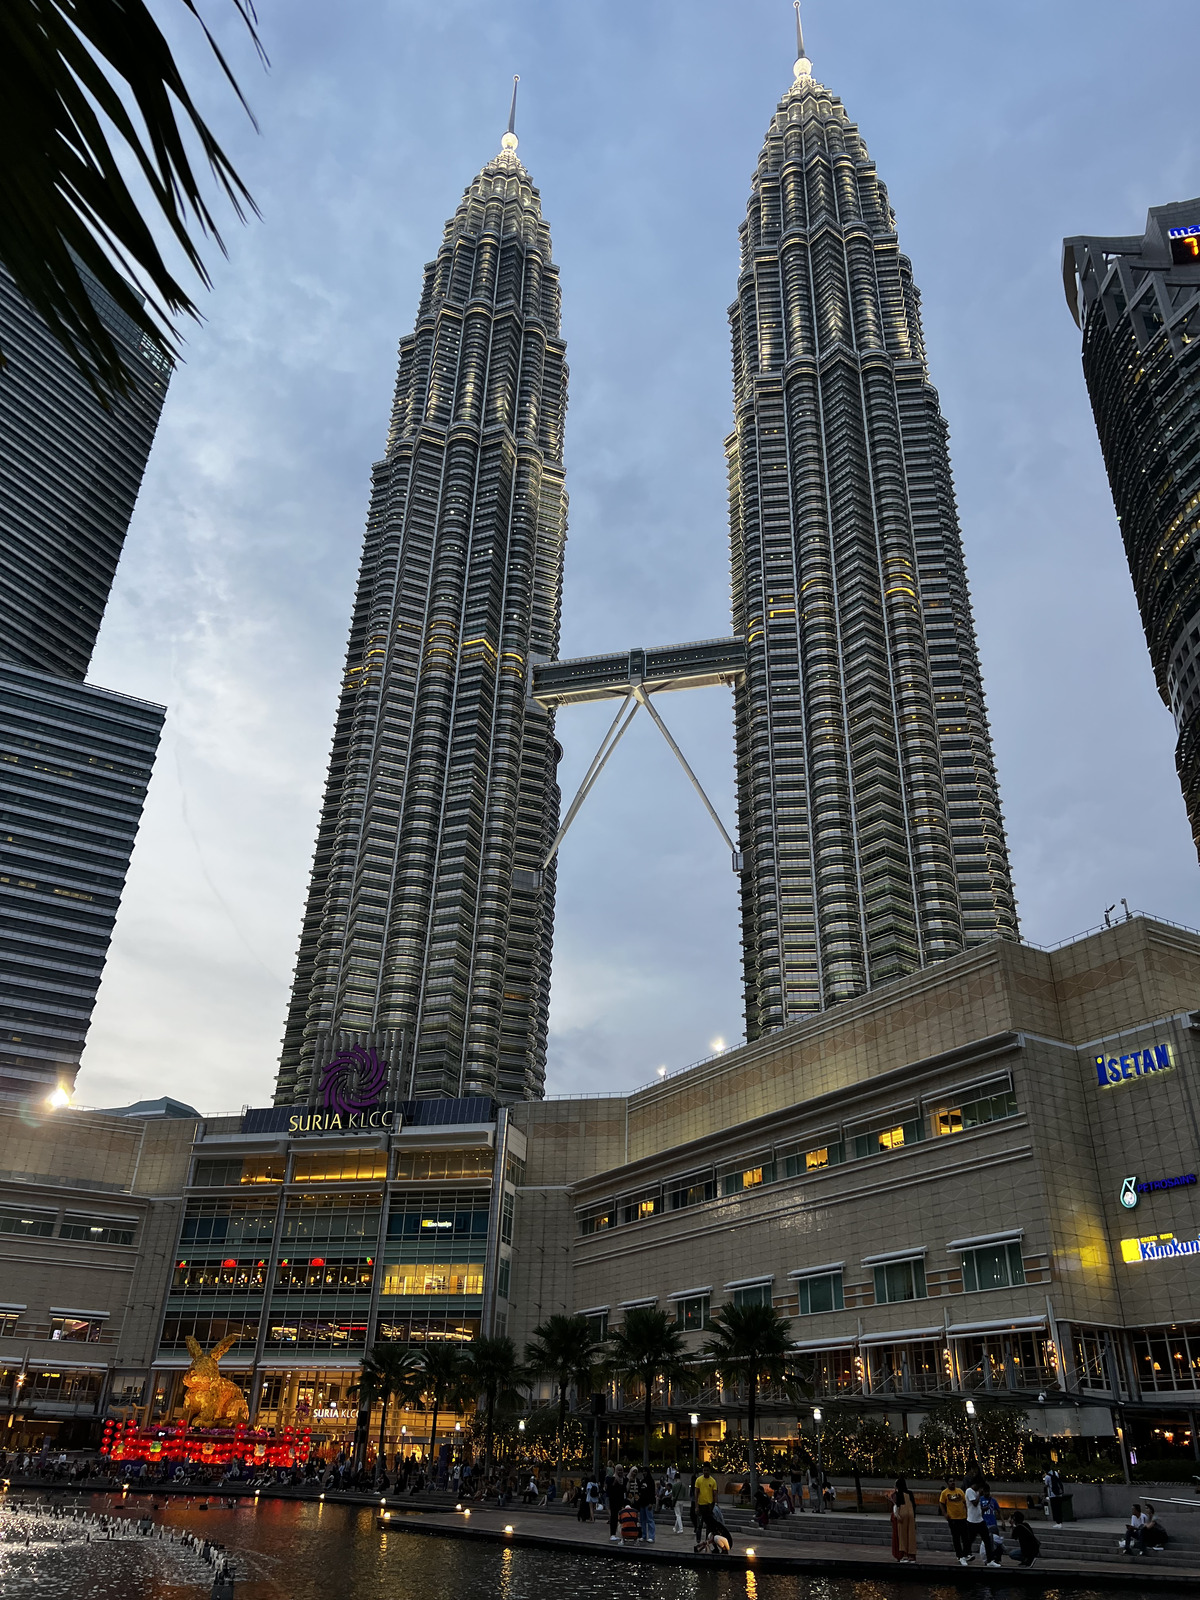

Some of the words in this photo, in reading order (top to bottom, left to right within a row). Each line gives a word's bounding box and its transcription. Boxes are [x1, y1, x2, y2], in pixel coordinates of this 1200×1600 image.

[1169, 224, 1200, 239] ma
[288, 1113, 342, 1132] SURIA
[348, 1110, 393, 1128] KLCC
[1137, 1174, 1196, 1193] PETROSAINS
[313, 1409, 339, 1418] SURIA
